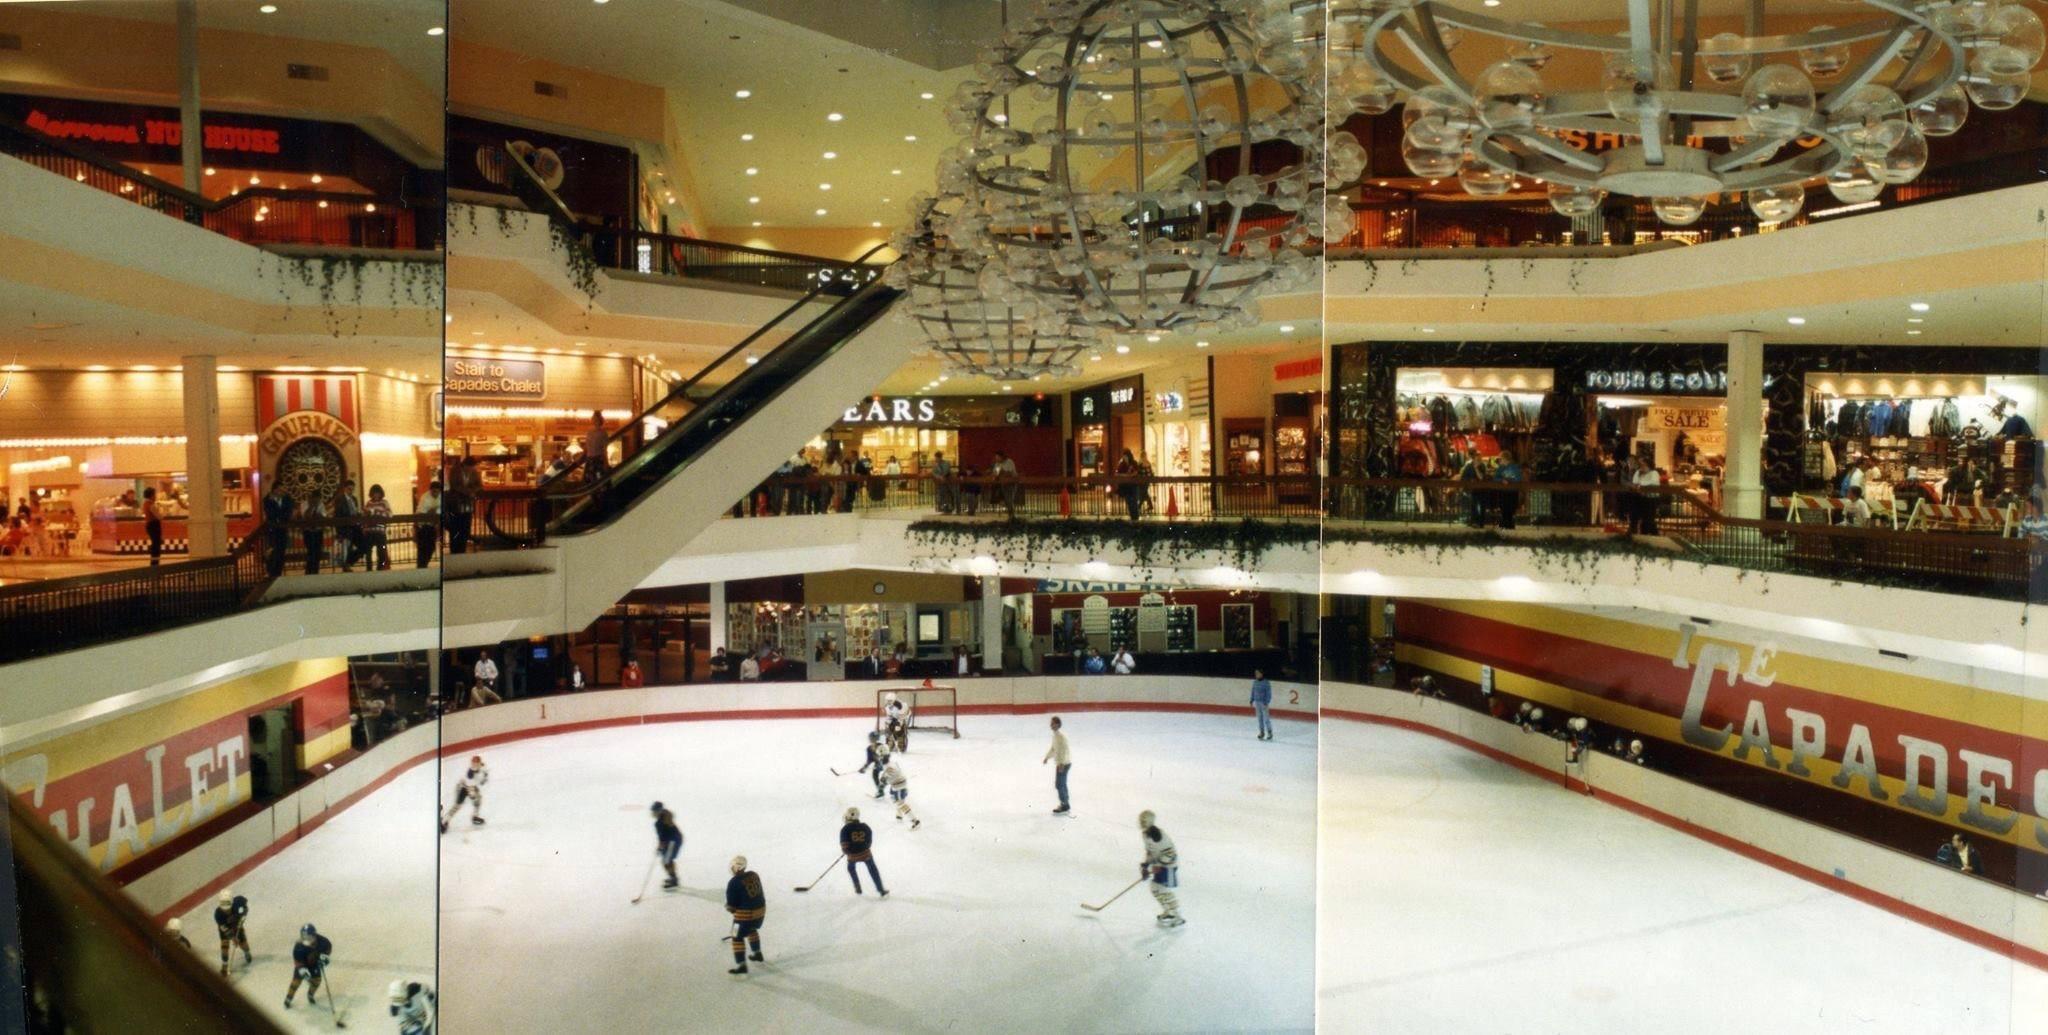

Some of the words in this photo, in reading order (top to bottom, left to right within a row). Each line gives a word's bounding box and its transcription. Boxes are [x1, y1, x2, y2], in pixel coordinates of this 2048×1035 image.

[145, 119, 182, 146] NU
[204, 125, 279, 153] HOUSE
[454, 361, 486, 376] Stair
[490, 365, 504, 376] to
[445, 376, 499, 393] apades
[501, 377, 542, 393] Chalet
[1585, 370, 1645, 390] TOWN
[1650, 371, 1665, 389] &
[1669, 370, 1776, 390] COUN
[843, 398, 935, 422] EARS
[1664, 415, 1709, 428] SALE
[263, 414, 356, 454] GOURMET
[1289, 689, 1299, 705] 2
[540, 704, 546, 719] 1
